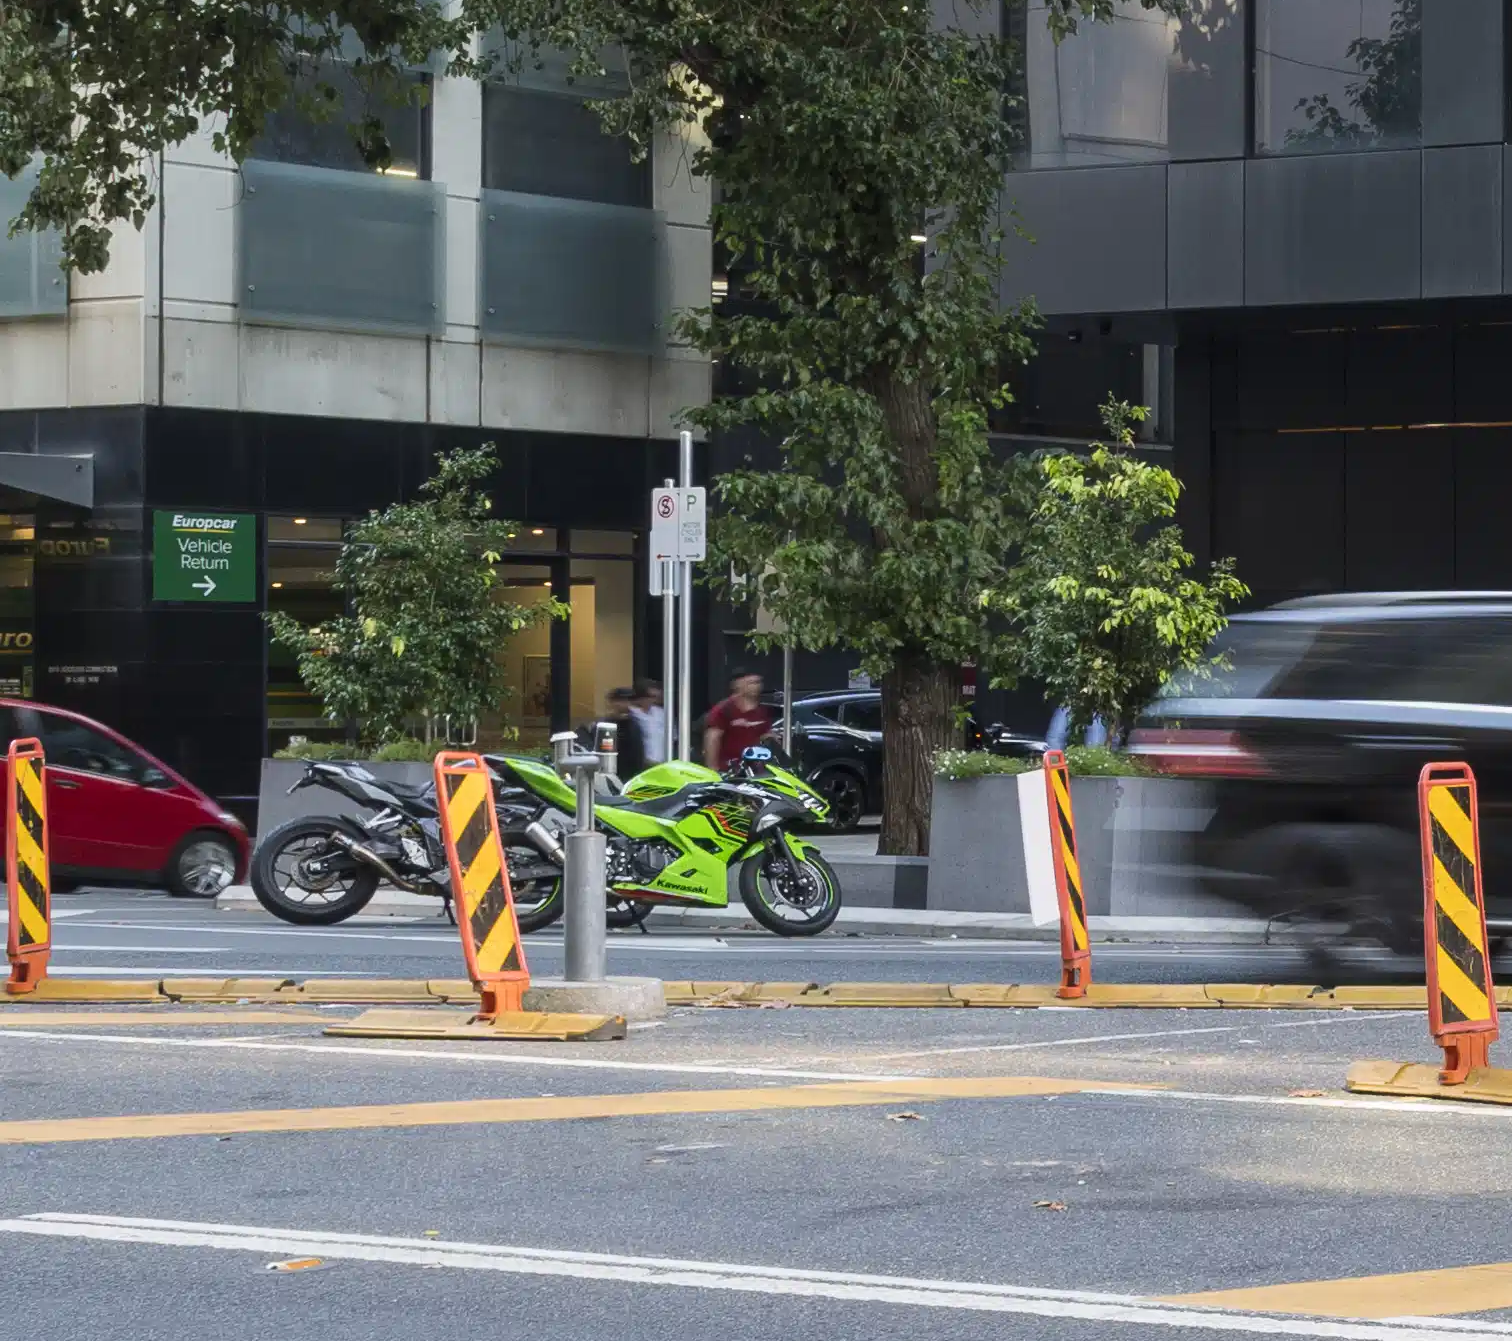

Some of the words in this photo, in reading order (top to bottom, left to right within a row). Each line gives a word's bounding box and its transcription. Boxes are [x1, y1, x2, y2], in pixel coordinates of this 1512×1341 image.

[687, 495, 697, 512] P
[172, 515, 237, 531] Europcar
[176, 538, 233, 554] Vehicle
[181, 555, 229, 570] Return
[656, 878, 709, 895] Kawasaki
